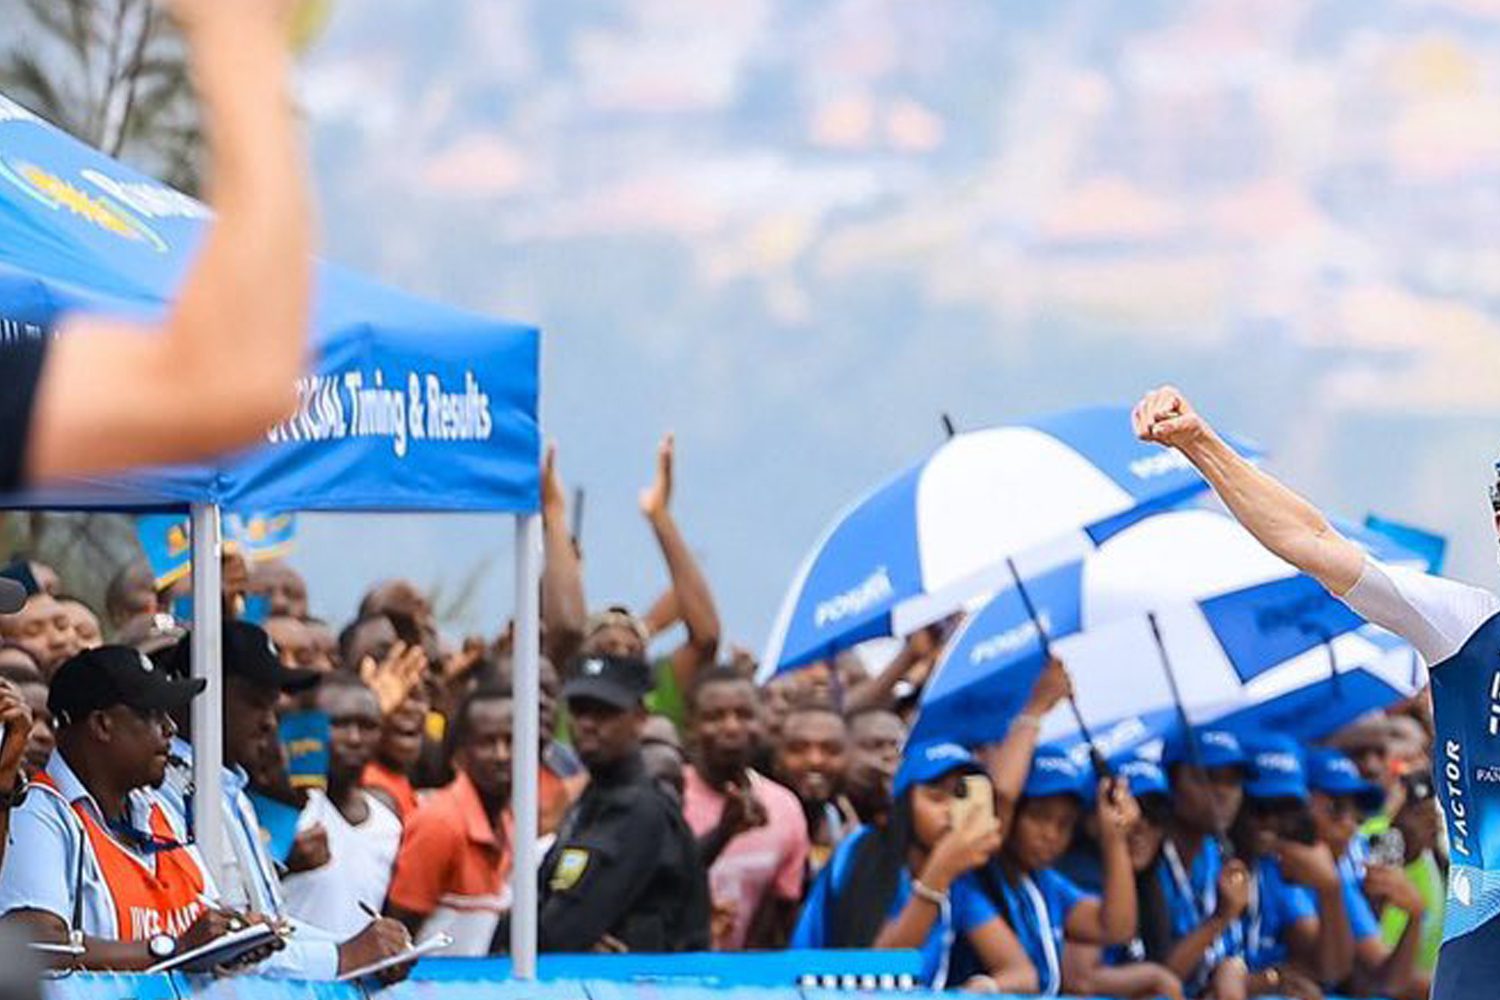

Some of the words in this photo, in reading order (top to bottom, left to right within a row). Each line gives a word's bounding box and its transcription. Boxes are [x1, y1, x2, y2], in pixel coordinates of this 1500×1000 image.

[344, 368, 407, 458] Timing
[408, 371, 426, 440] &
[425, 370, 493, 441] Results
[1446, 740, 1470, 856] FACTOR
